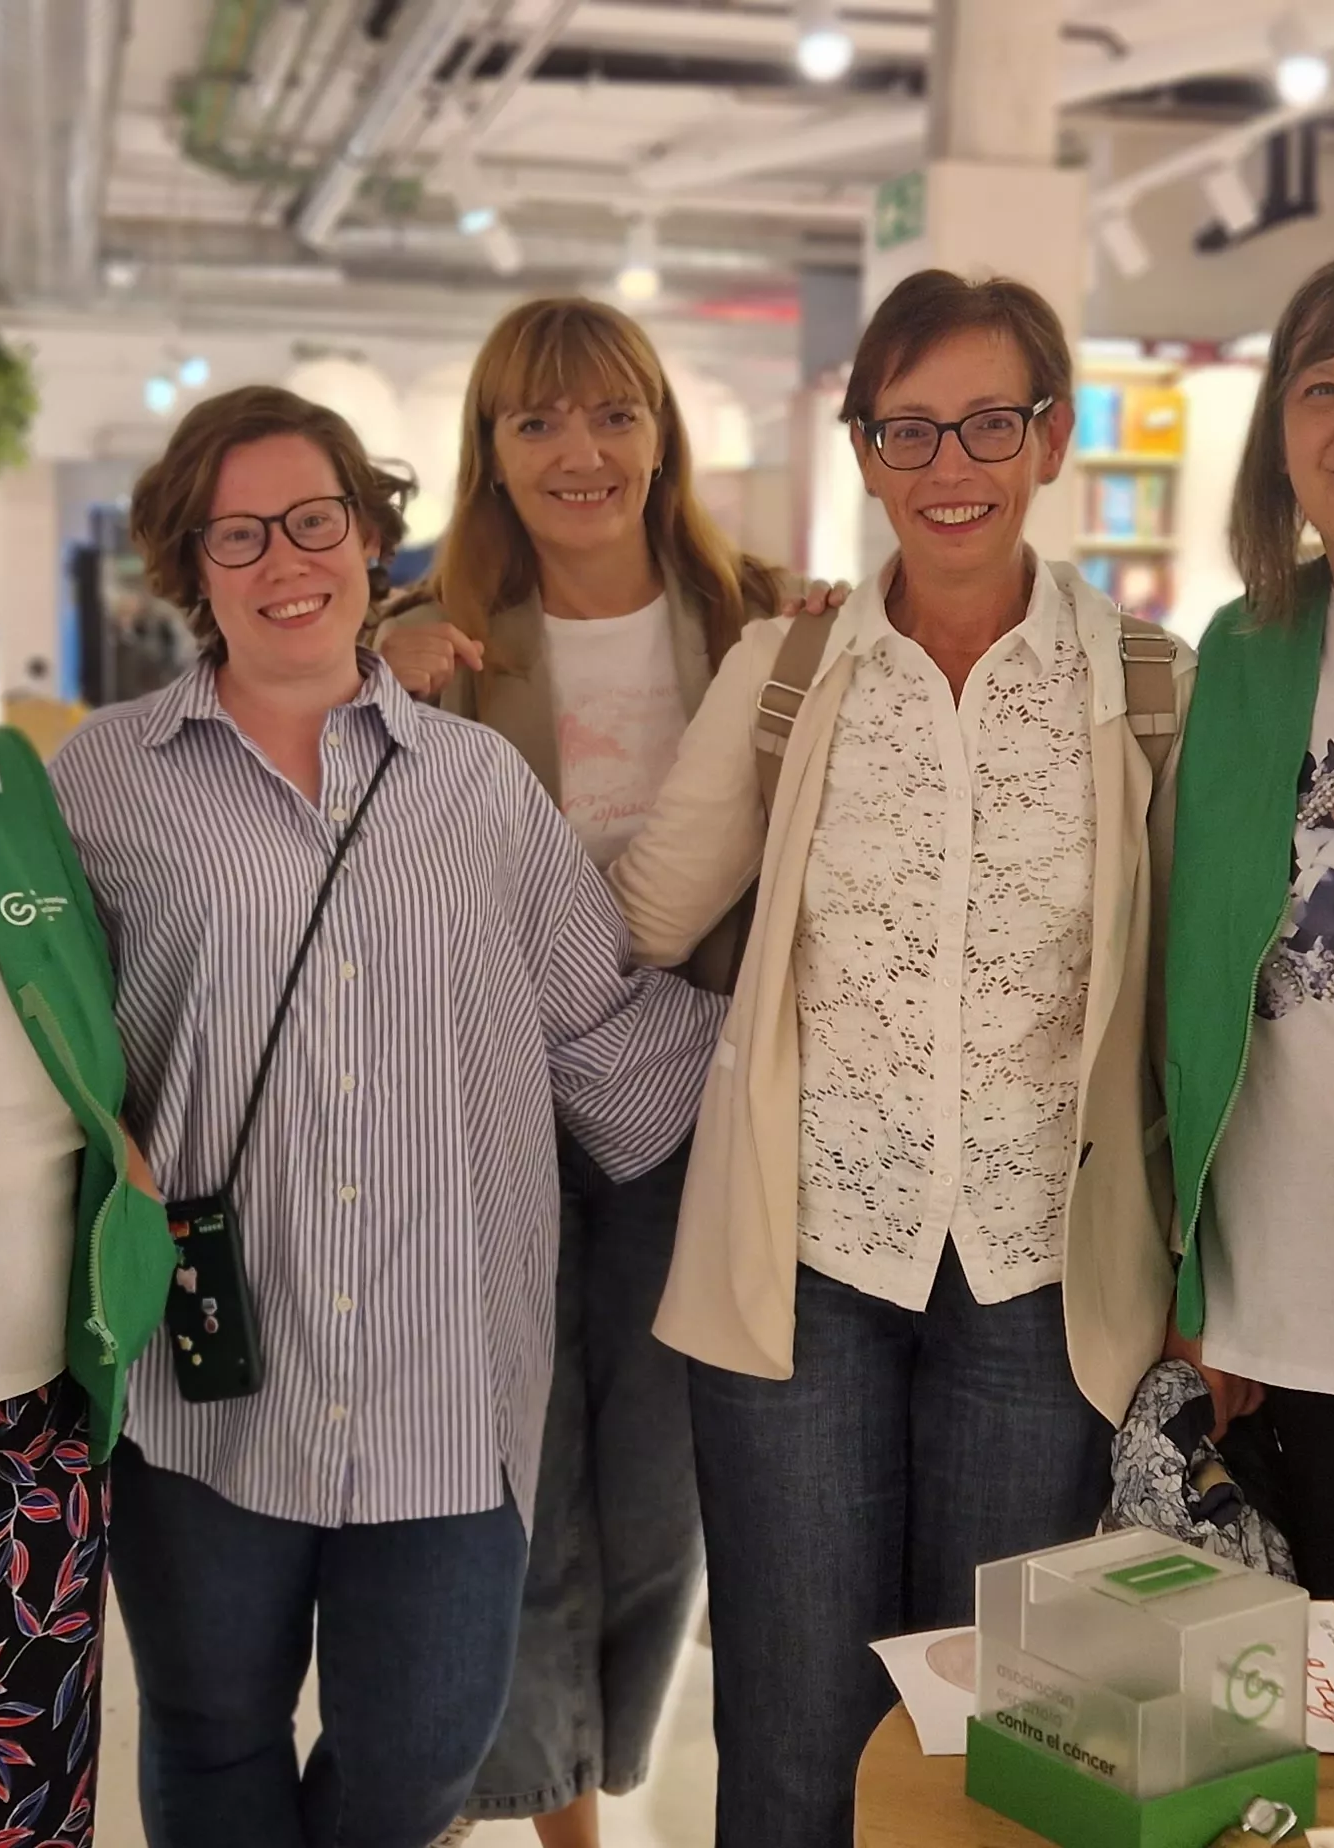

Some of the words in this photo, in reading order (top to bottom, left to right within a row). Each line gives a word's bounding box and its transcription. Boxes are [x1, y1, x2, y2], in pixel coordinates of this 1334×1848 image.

[996, 1663, 1075, 1711] asociación
[996, 1710, 1044, 1743] contra
[1046, 1733, 1060, 1751] el
[1062, 1742, 1117, 1776] cáncer
